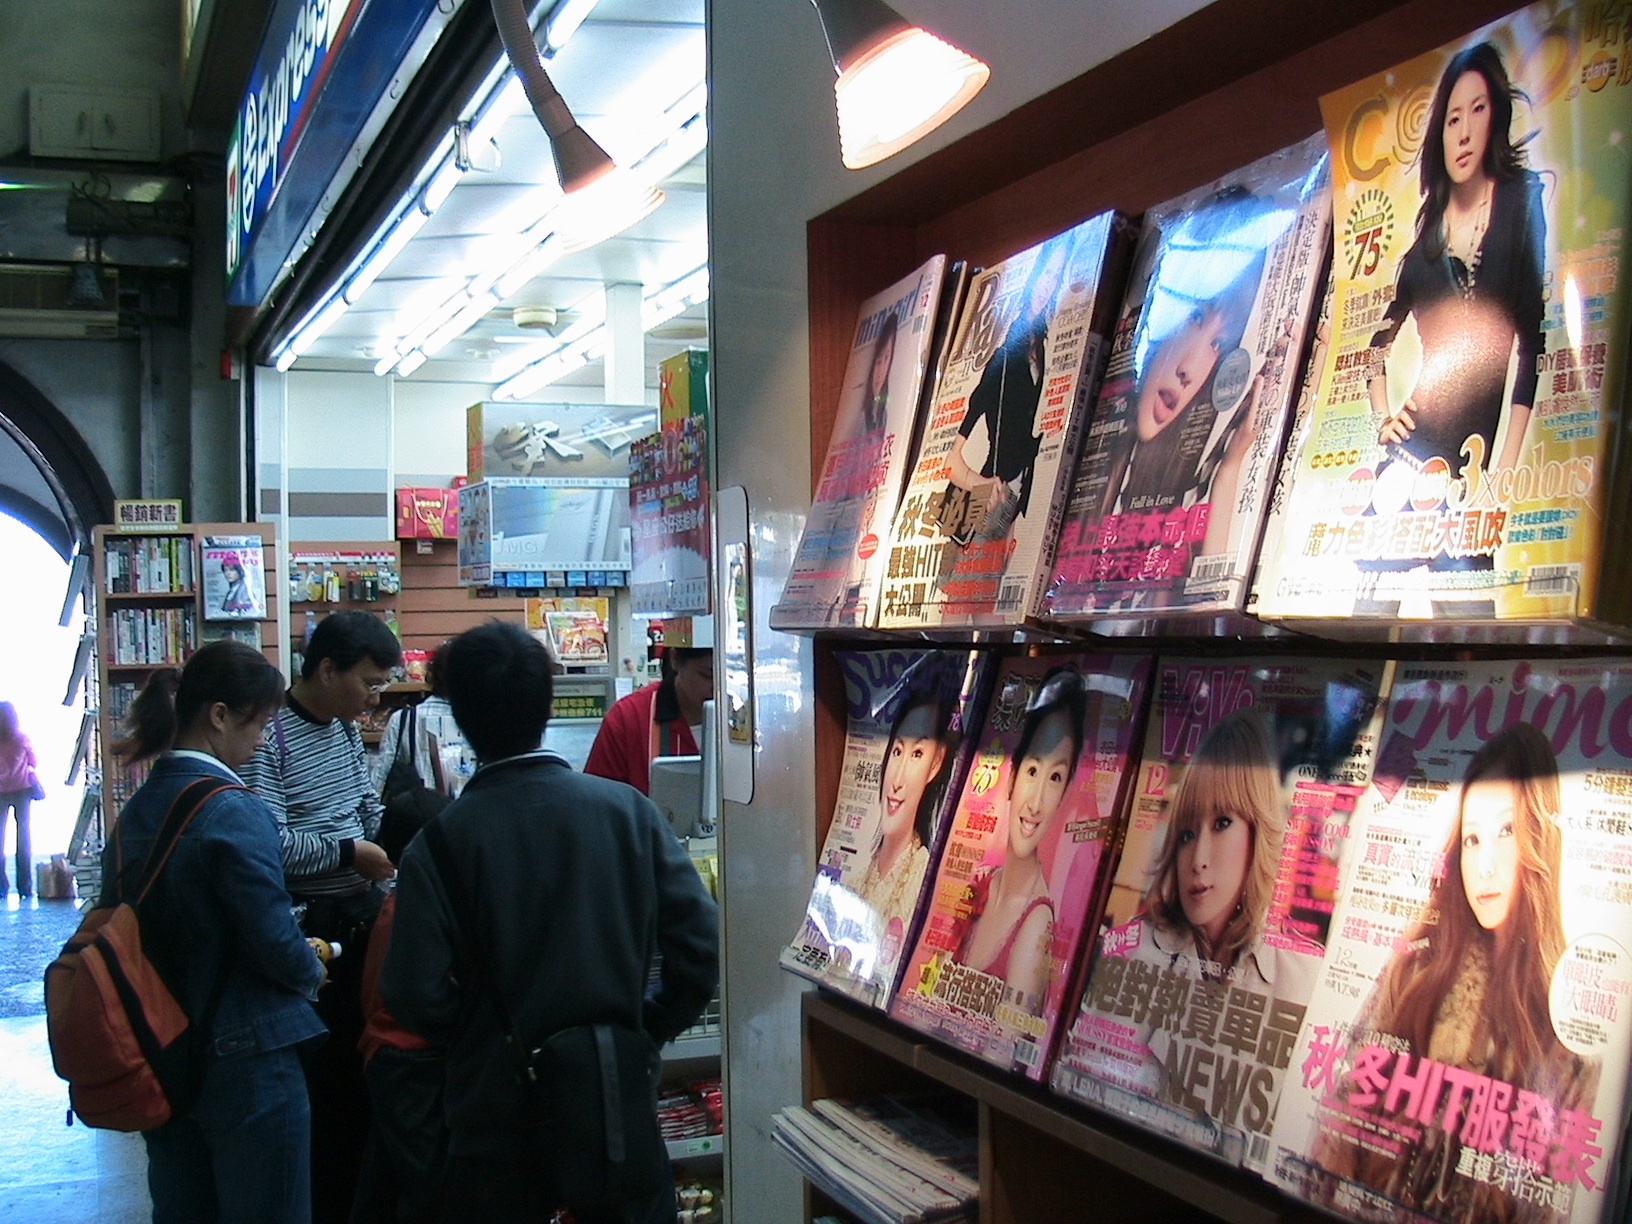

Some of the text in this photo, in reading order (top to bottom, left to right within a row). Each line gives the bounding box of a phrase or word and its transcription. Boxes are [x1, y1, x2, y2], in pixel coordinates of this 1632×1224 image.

[1351, 227, 1383, 281] 75
[120, 504, 177, 523] 暢銷新書
[1324, 821, 1351, 840] COOL
